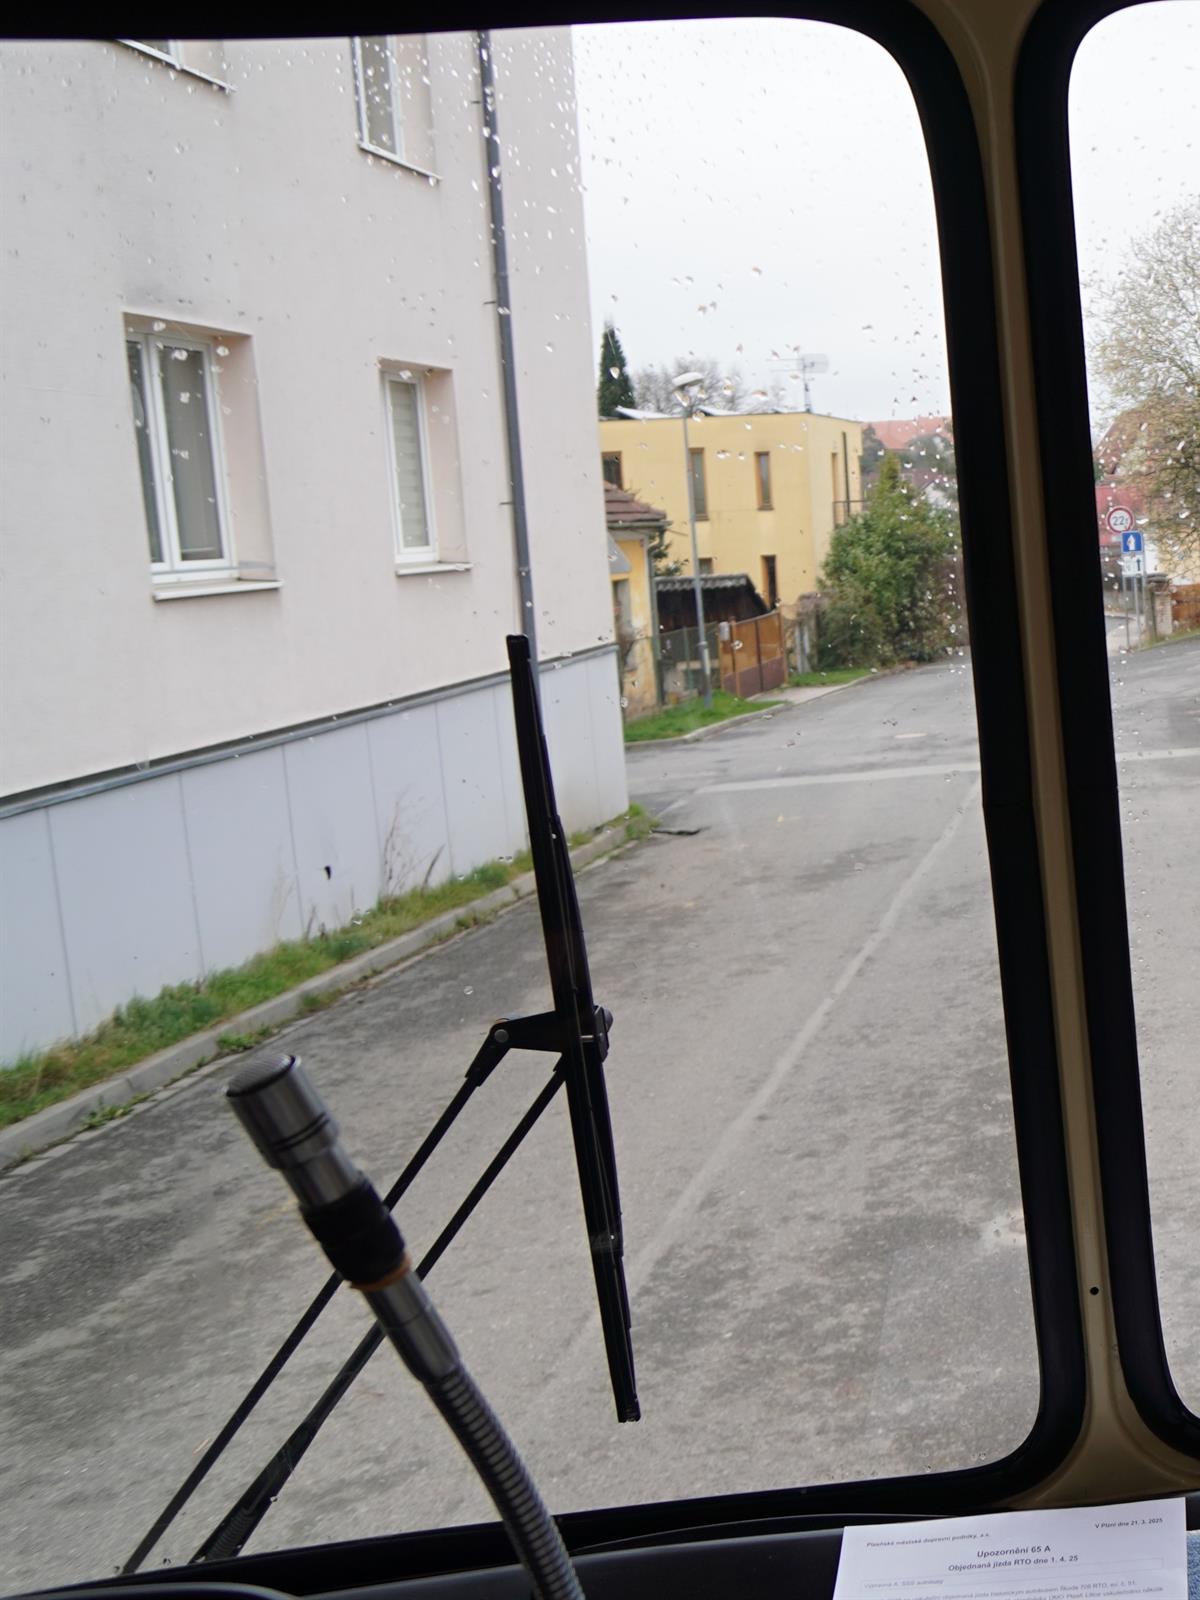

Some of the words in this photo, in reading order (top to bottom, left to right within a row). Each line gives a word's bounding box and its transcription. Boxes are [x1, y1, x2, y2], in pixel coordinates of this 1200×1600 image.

[977, 1546, 1028, 1558] Upozornění
[1031, 1545, 1042, 1553] 65
[948, 1561, 991, 1572] Objednaná
[992, 1560, 1012, 1569] jízda
